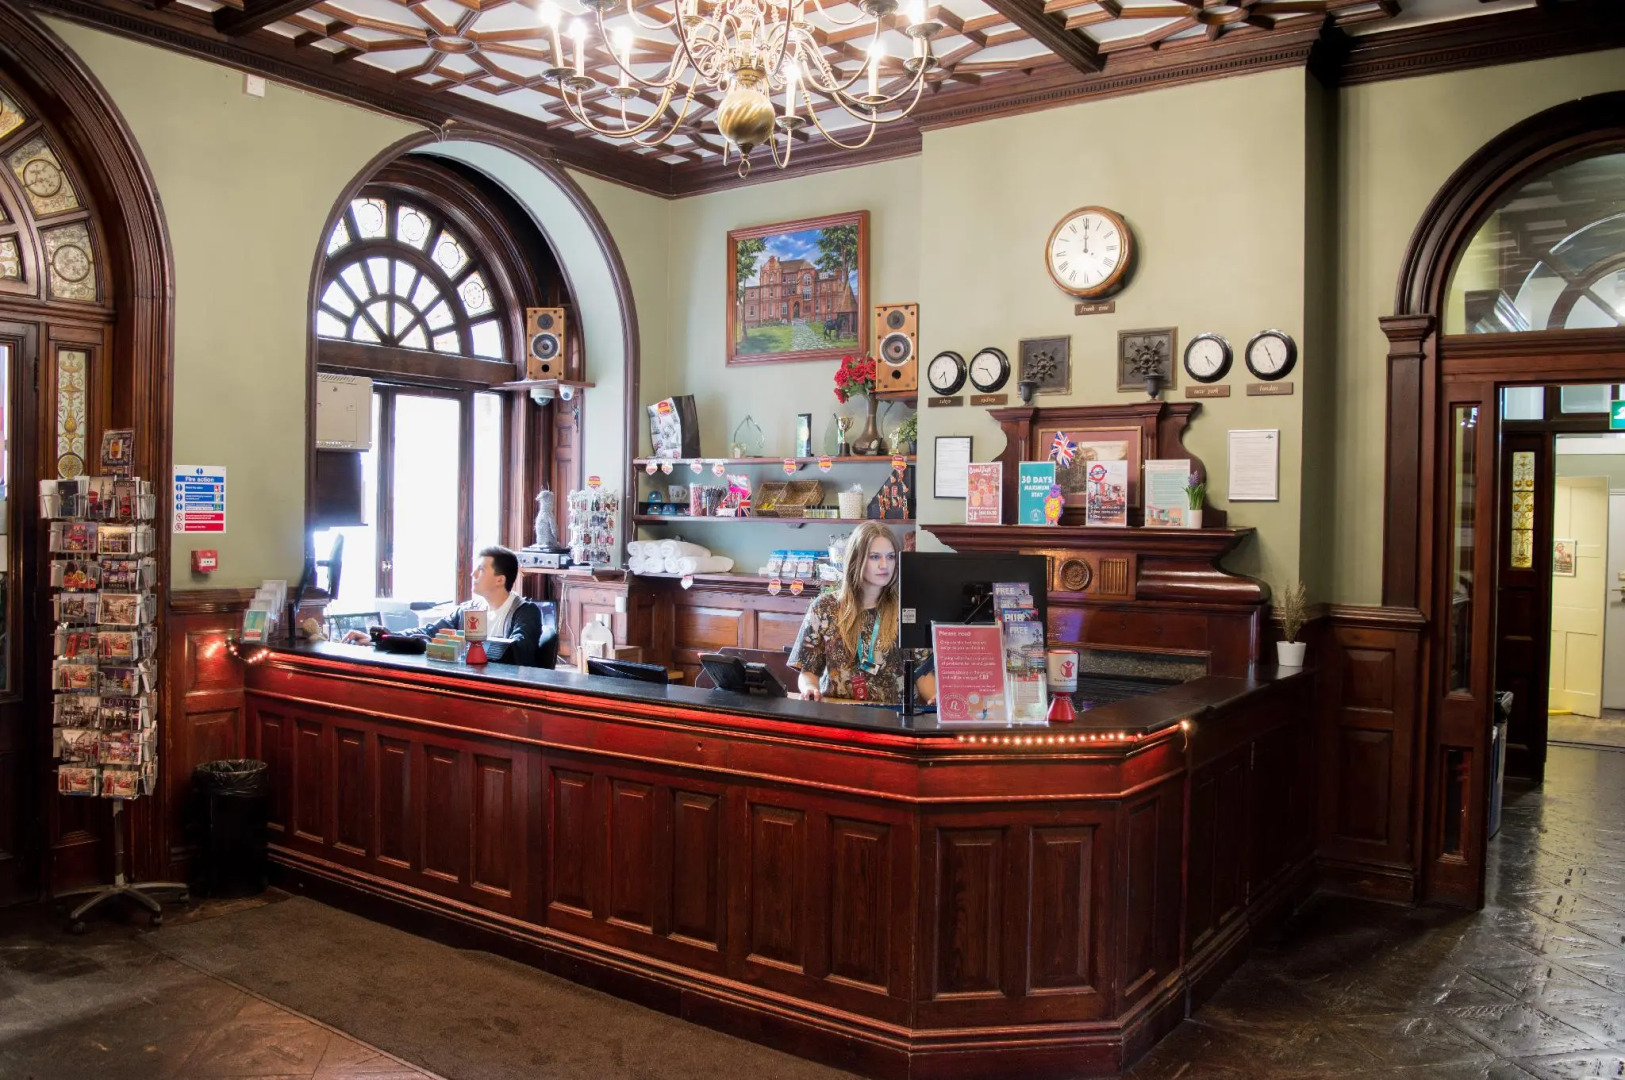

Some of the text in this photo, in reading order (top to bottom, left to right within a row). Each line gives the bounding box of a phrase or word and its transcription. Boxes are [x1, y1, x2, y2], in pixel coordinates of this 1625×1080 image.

[1021, 476, 1053, 484] 30 DAYS
[995, 587, 1015, 595] FREE
[1010, 626, 1028, 634] FREE
[102, 698, 140, 706] LONDON
